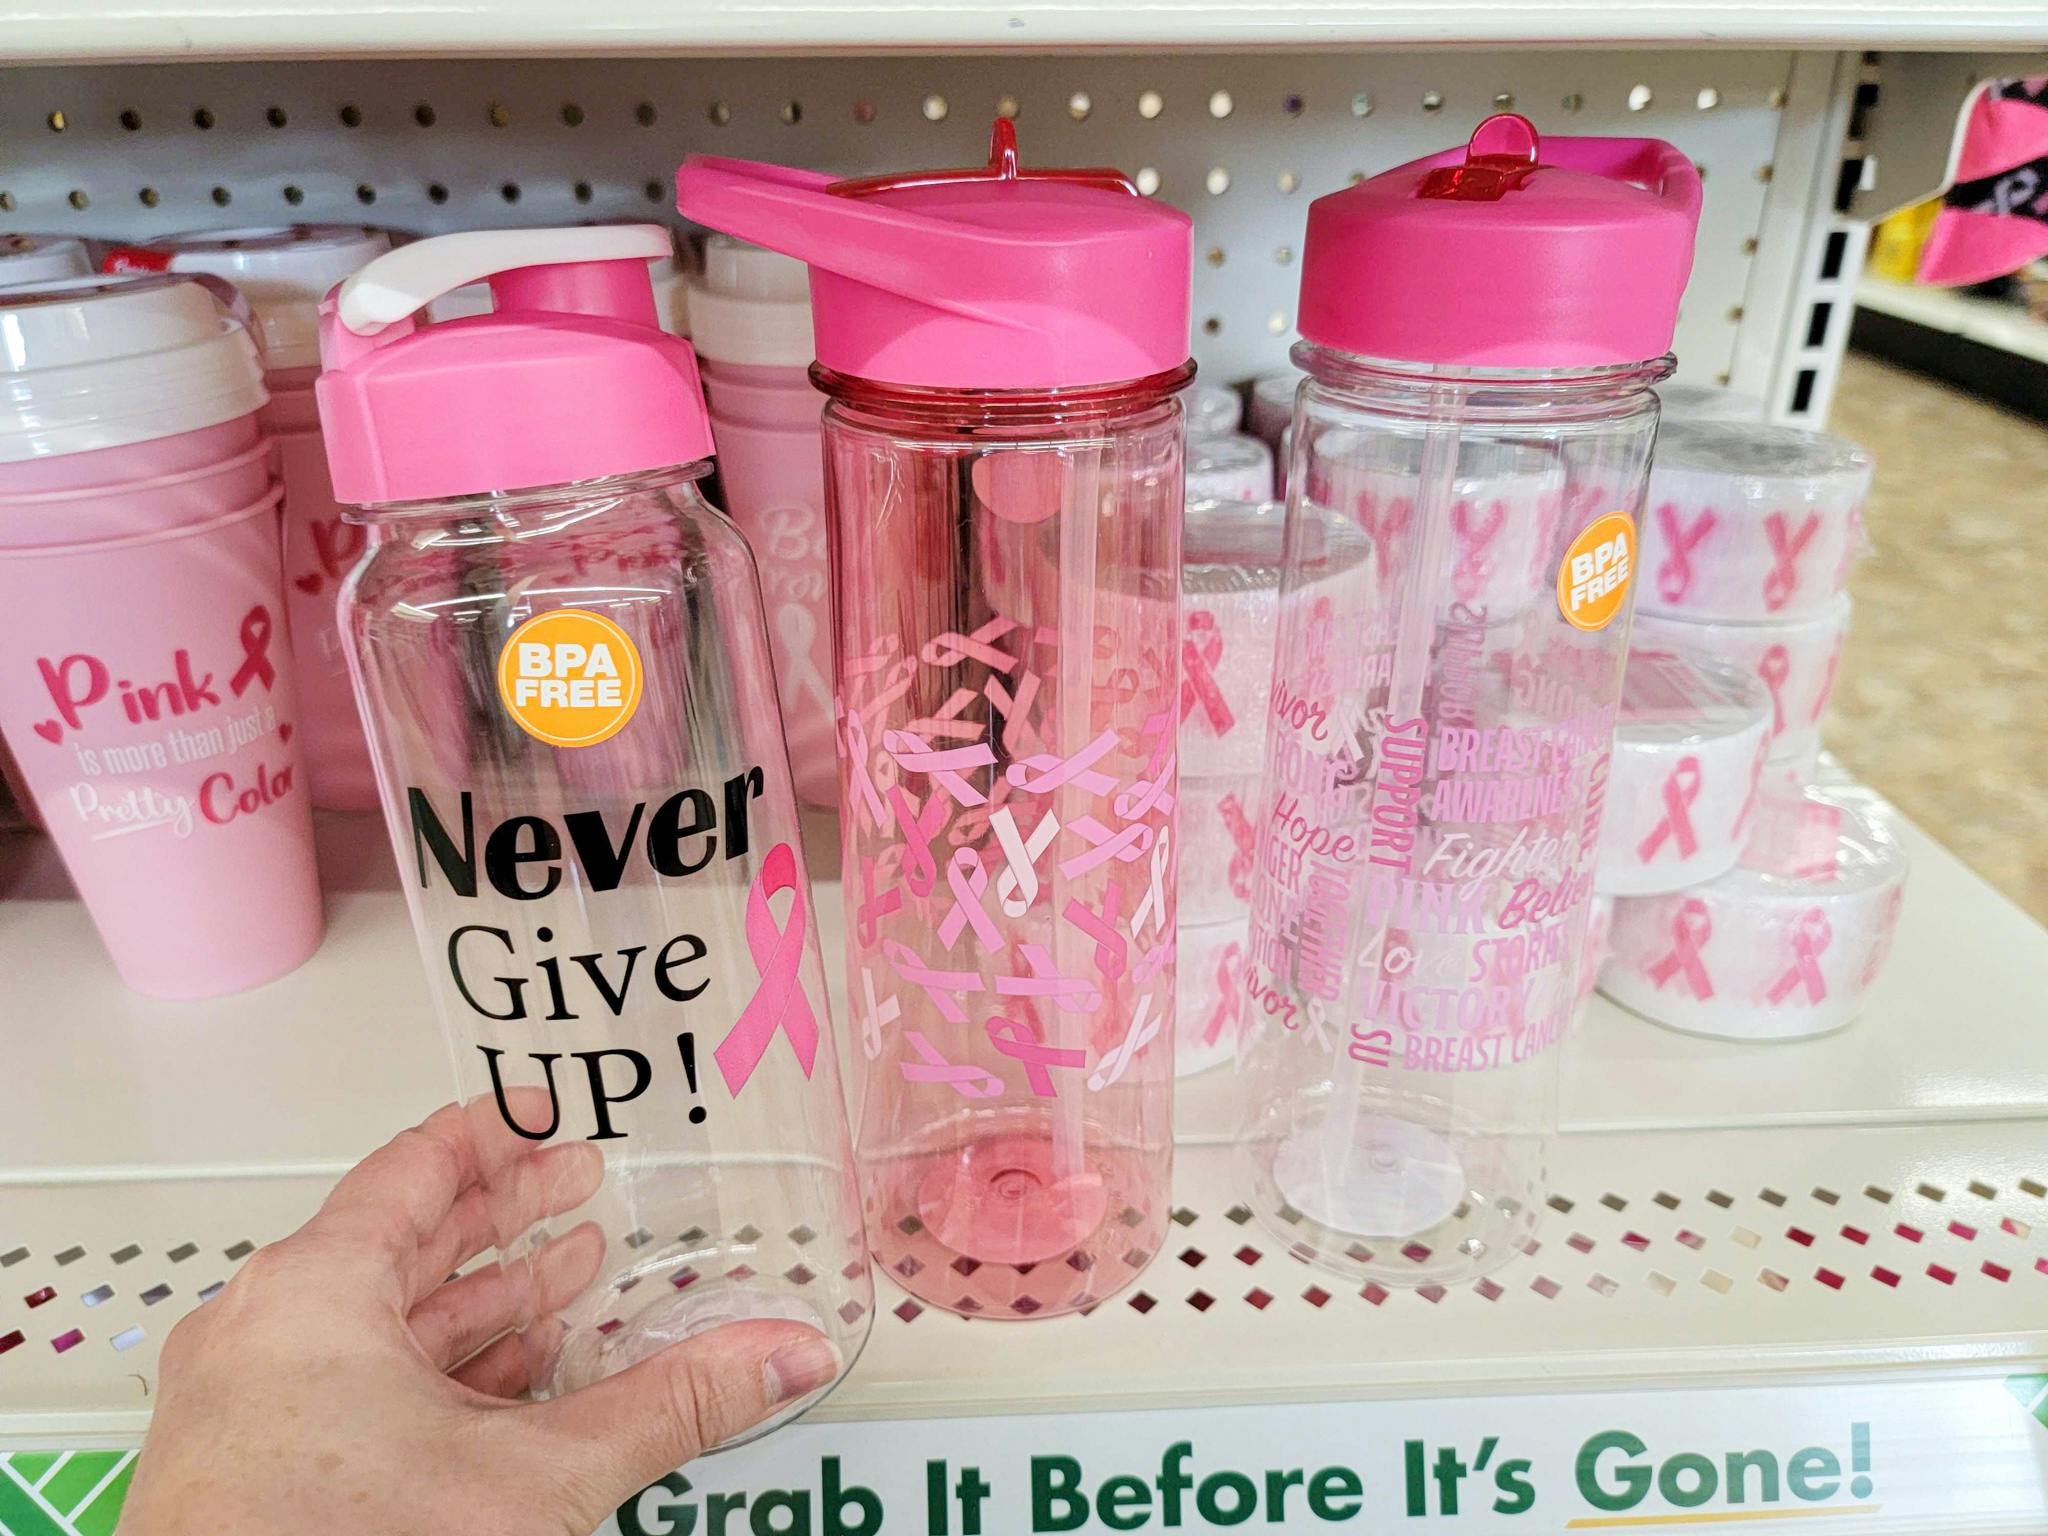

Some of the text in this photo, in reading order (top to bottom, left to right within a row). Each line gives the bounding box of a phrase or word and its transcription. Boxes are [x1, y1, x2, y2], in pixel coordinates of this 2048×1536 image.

[1571, 532, 1628, 586] BPA
[1571, 557, 1629, 611] FREE
[36, 649, 221, 730] Pink
[518, 643, 618, 677] BPA
[515, 678, 623, 708] FREE
[74, 741, 101, 776] is
[103, 742, 168, 775] more
[168, 728, 225, 764] than
[226, 711, 262, 755] just
[1439, 726, 1544, 773] BREAST
[69, 782, 196, 839] Pretty
[1369, 714, 1428, 876] SUPPORT
[407, 766, 765, 901] Never
[1272, 791, 1356, 864] Hope
[1366, 874, 1488, 936] PINK
[448, 925, 711, 1020] Give
[1362, 972, 1536, 1034] VICTORY
[1402, 1031, 1507, 1073] BREAST
[476, 1031, 708, 1141] UP!
[616, 1421, 1874, 1536] Grab It Before It's Gone!
